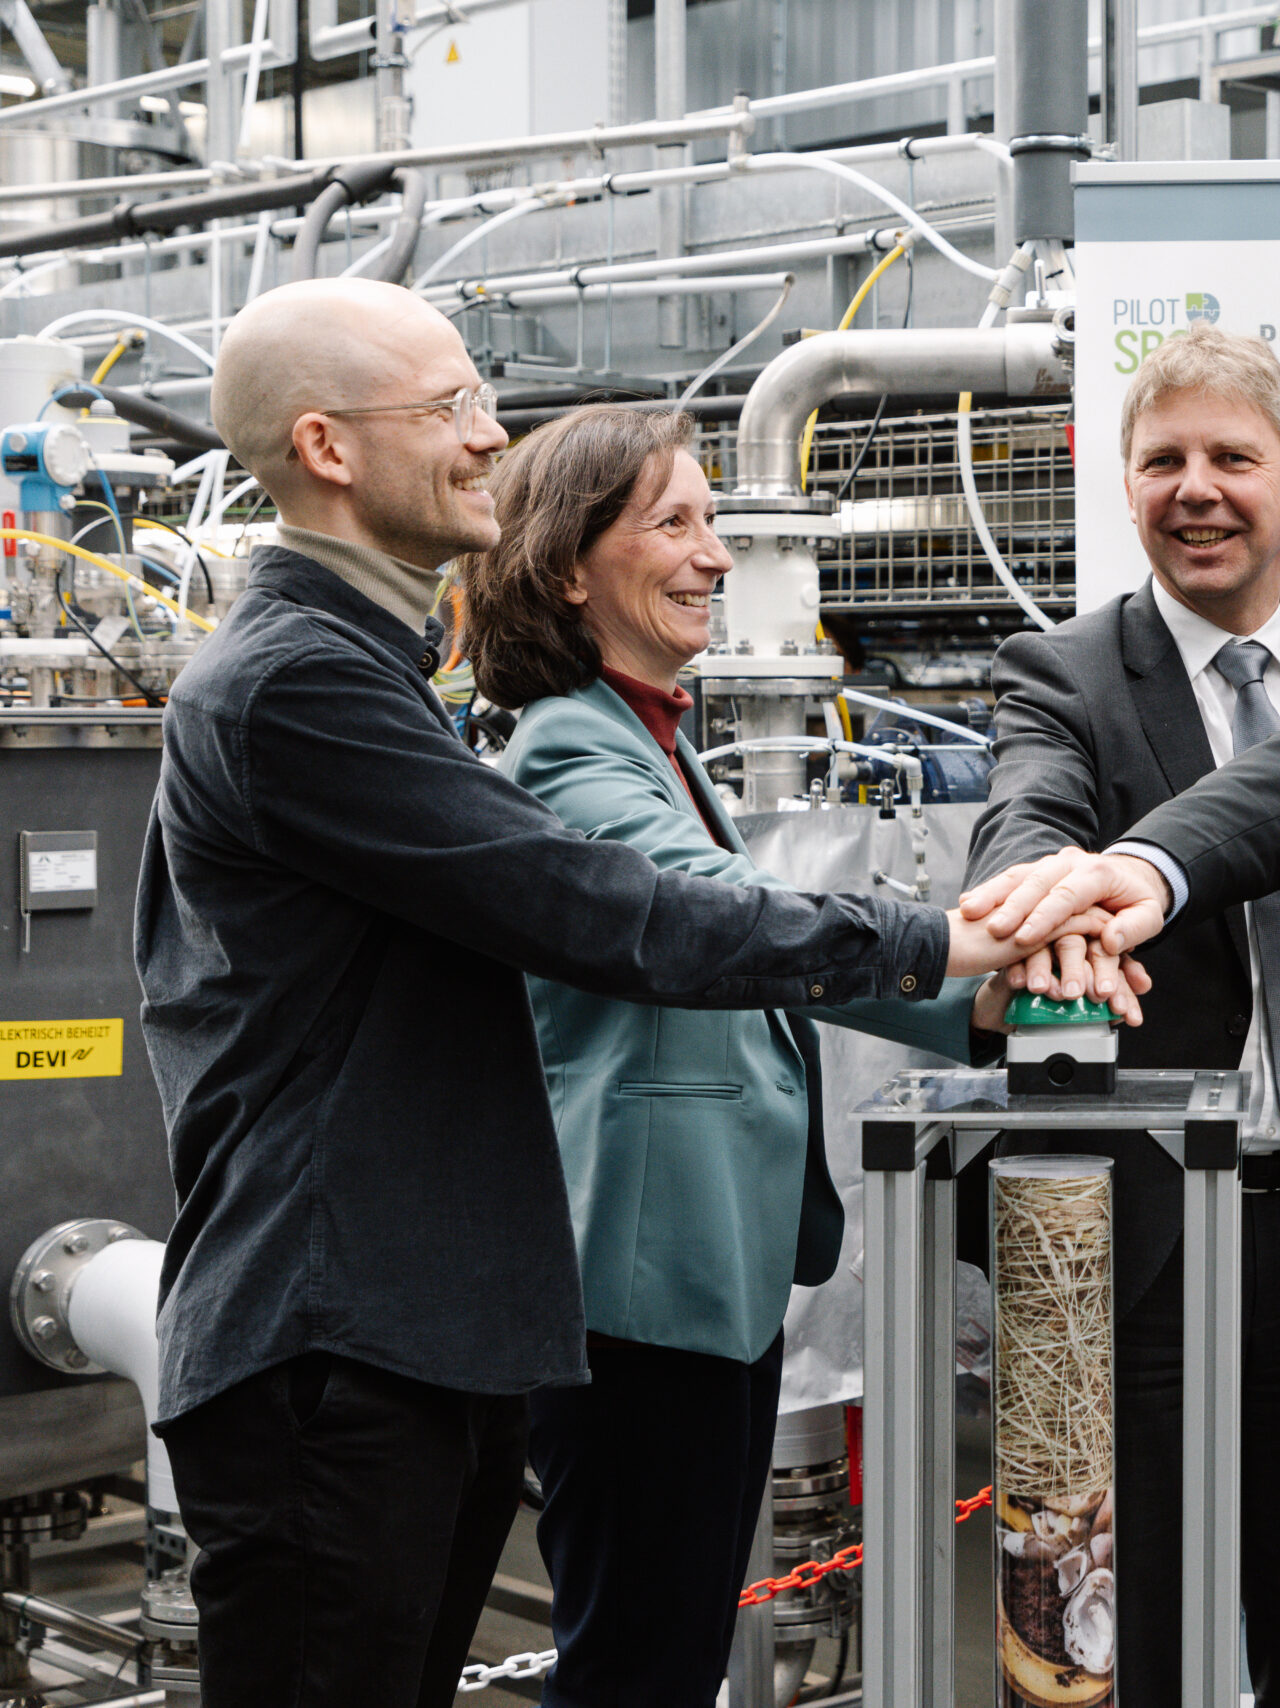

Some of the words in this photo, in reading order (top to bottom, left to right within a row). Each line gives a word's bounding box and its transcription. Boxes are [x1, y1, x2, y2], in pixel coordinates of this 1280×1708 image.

[1113, 298, 1180, 325] PILOT
[66, 1025, 111, 1039] BEHEIZT
[16, 1049, 66, 1069] DEVI
